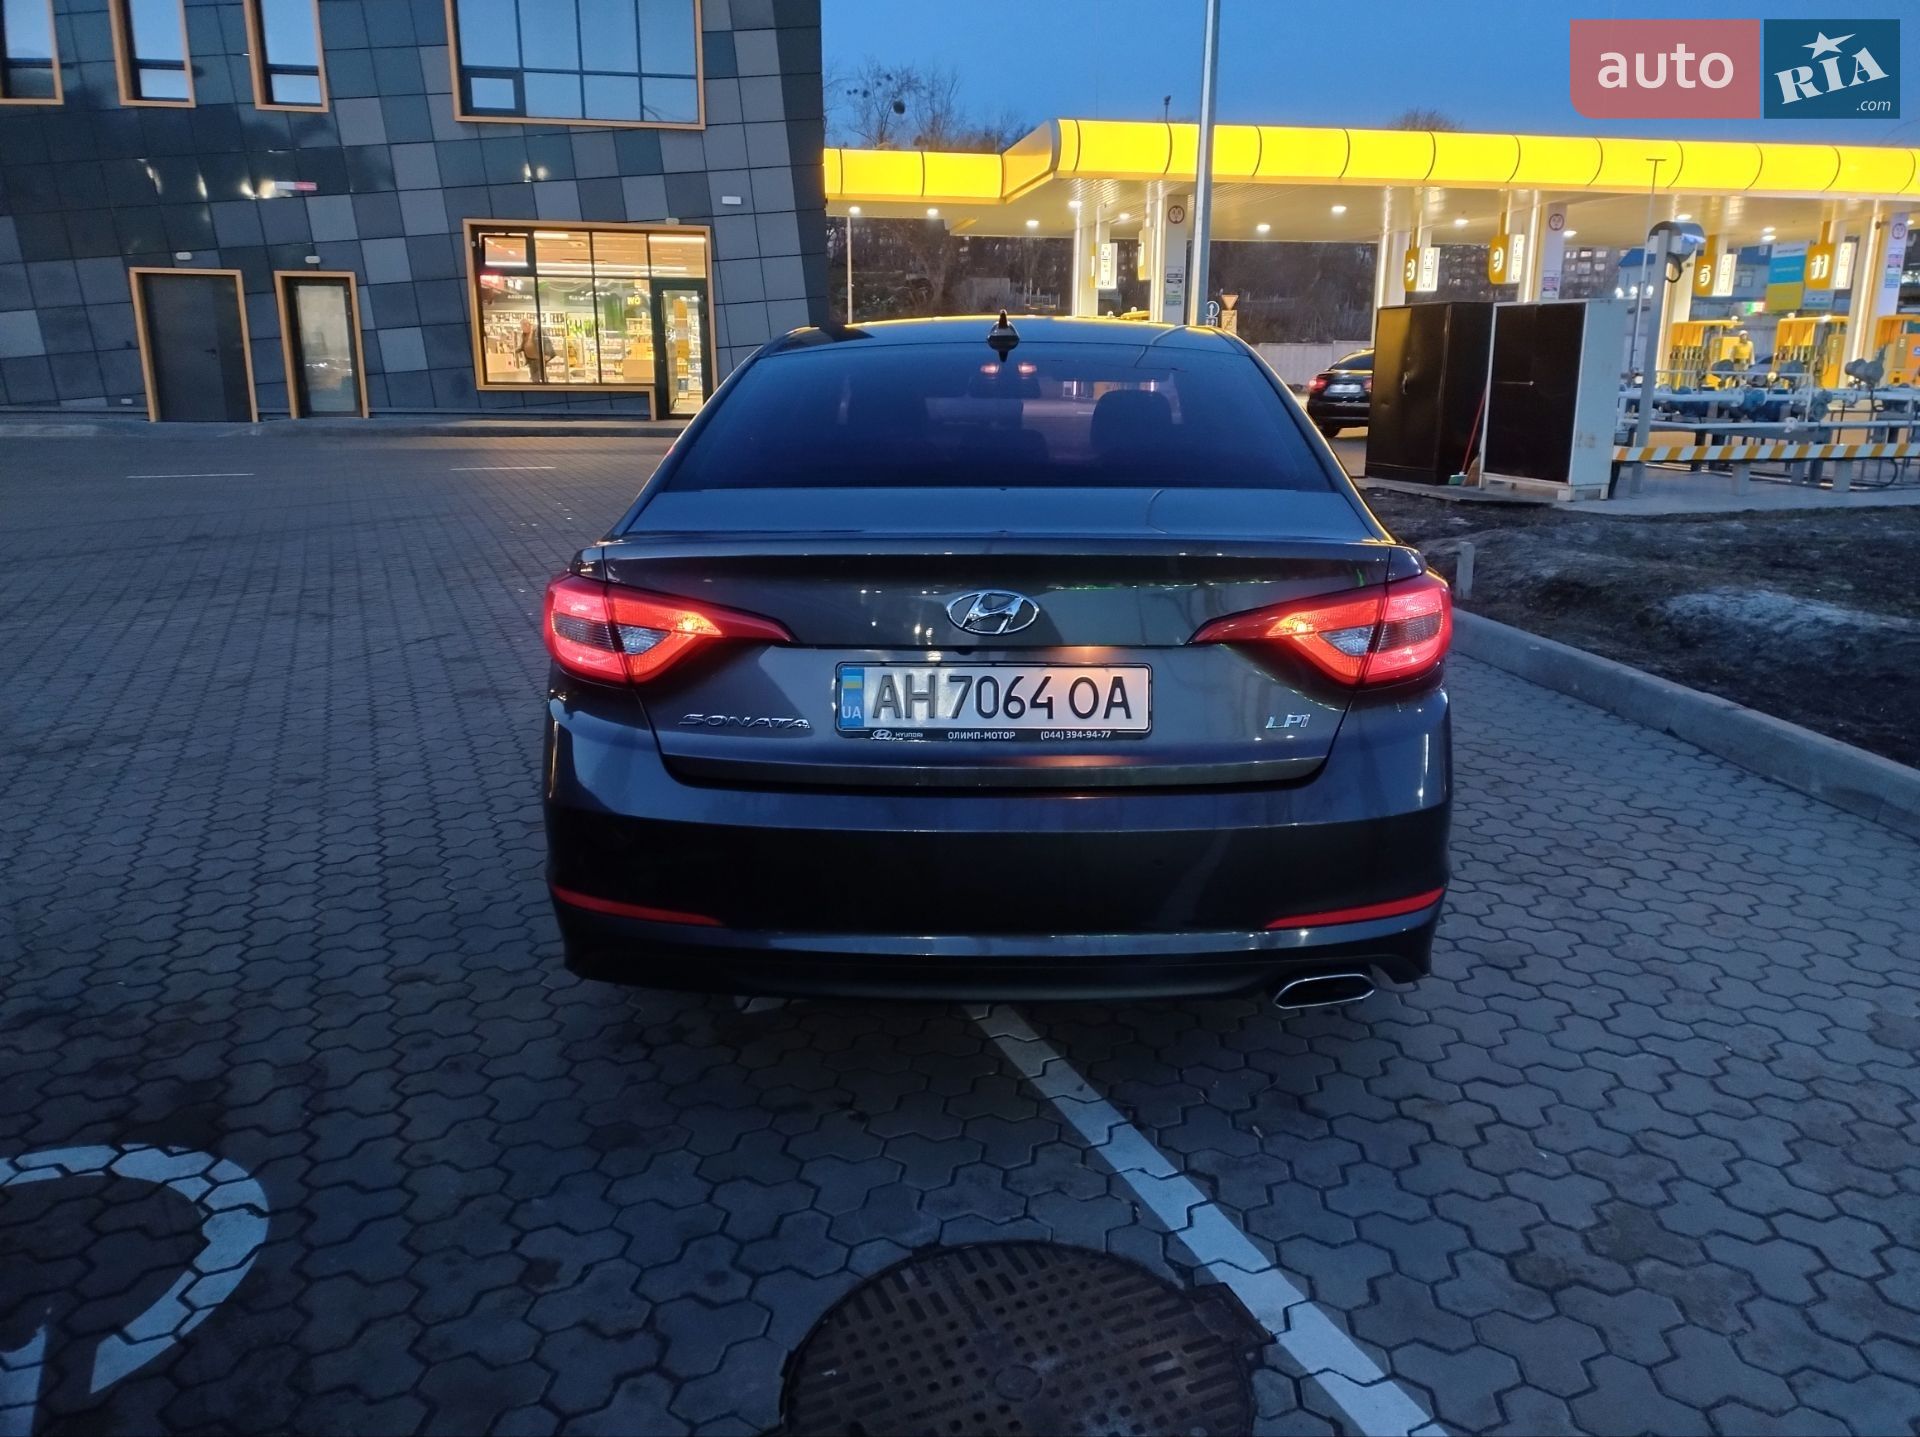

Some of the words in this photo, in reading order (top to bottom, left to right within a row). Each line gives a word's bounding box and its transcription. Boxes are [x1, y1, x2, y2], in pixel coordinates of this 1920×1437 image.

[872, 675, 936, 719] AH
[949, 675, 1053, 720] 7064
[1068, 676, 1133, 720] OA
[841, 706, 862, 719] UA
[678, 713, 811, 729] SONATA
[947, 731, 1016, 740] ОЛИМП-МОТОР
[1040, 730, 1064, 741] (044)
[1066, 730, 1112, 739] 394-94-77
